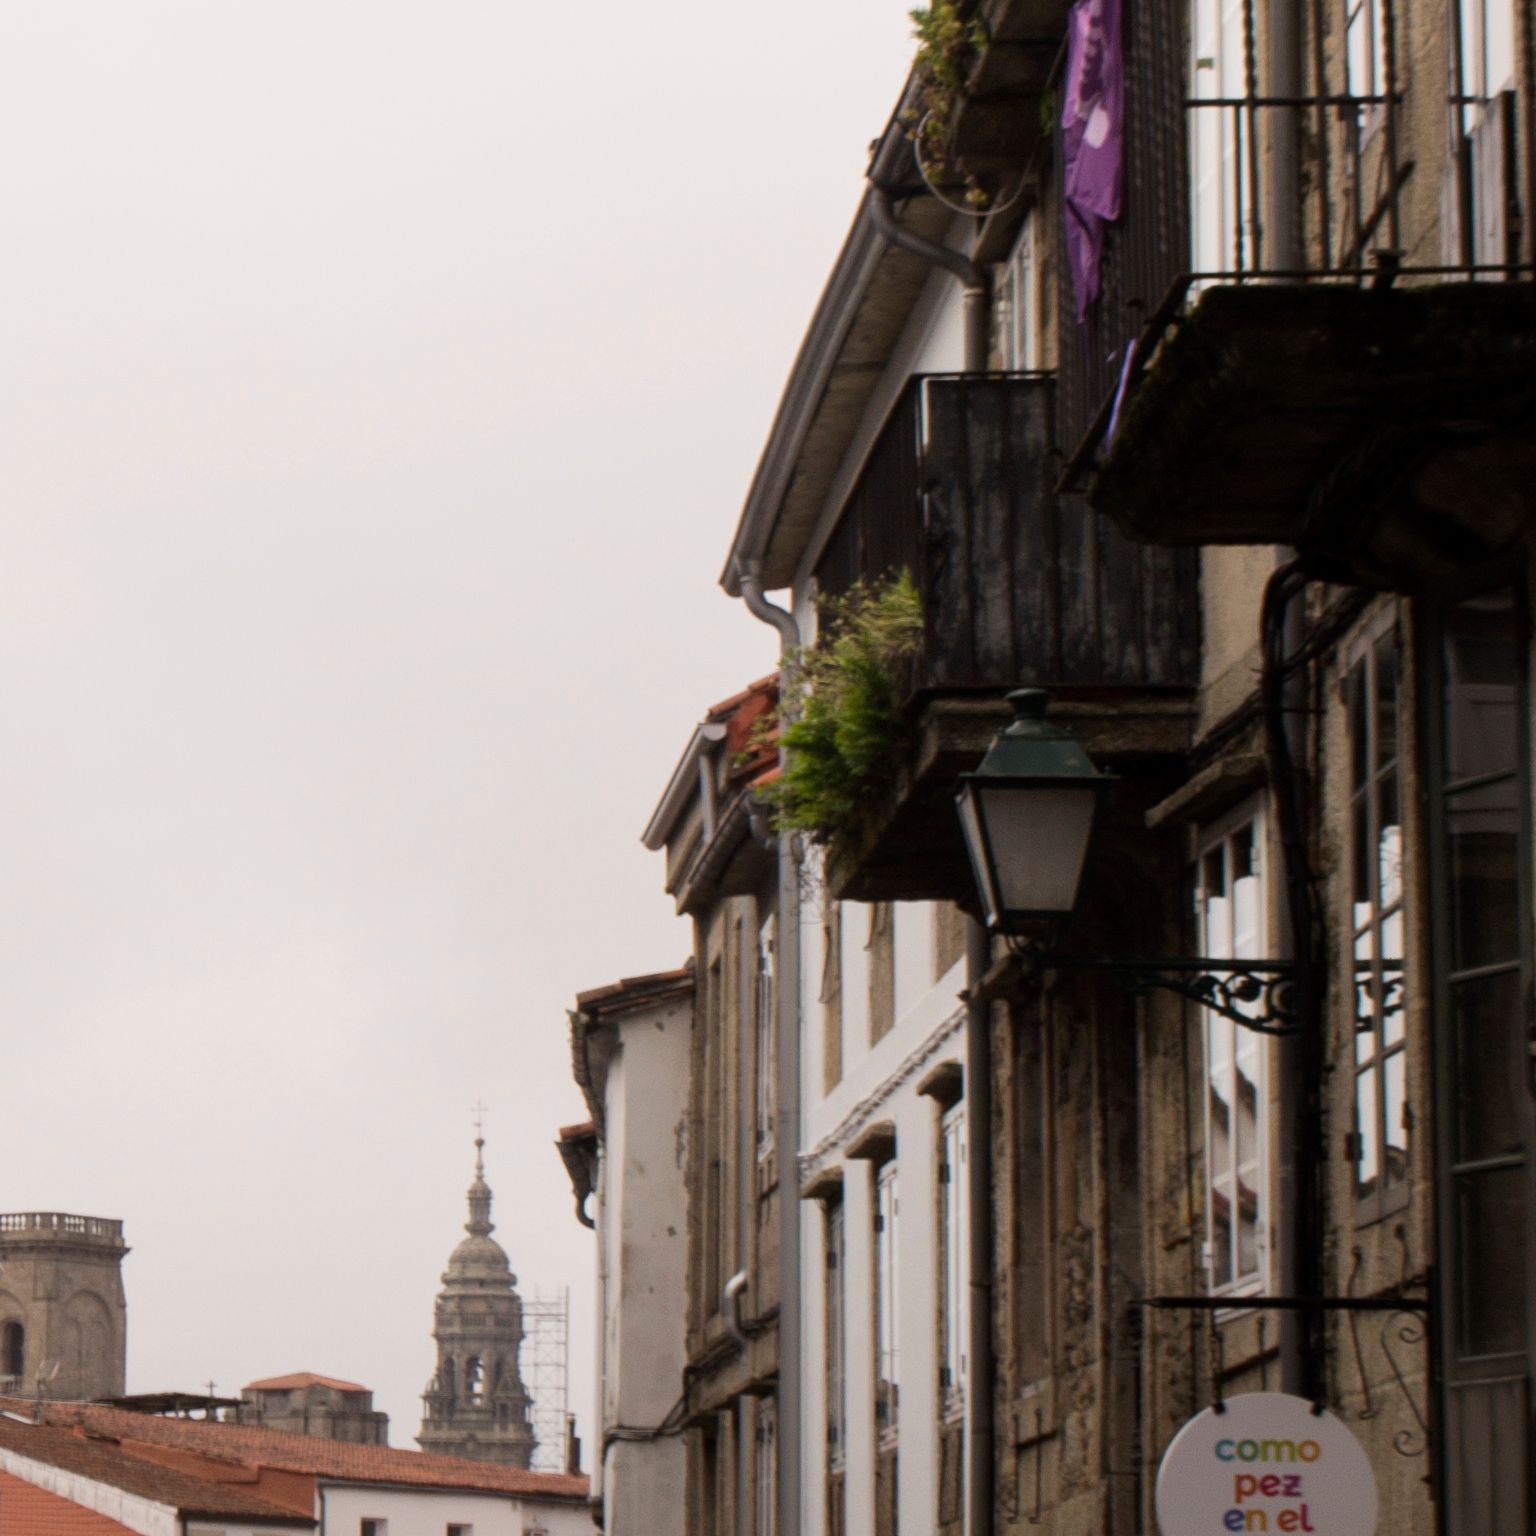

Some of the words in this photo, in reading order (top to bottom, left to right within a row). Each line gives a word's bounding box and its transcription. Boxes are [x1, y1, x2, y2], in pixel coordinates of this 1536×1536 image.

[1215, 1438, 1321, 1462] como
[1233, 1473, 1302, 1503] pez
[1223, 1509, 1268, 1532] en
[1277, 1503, 1314, 1532] el
